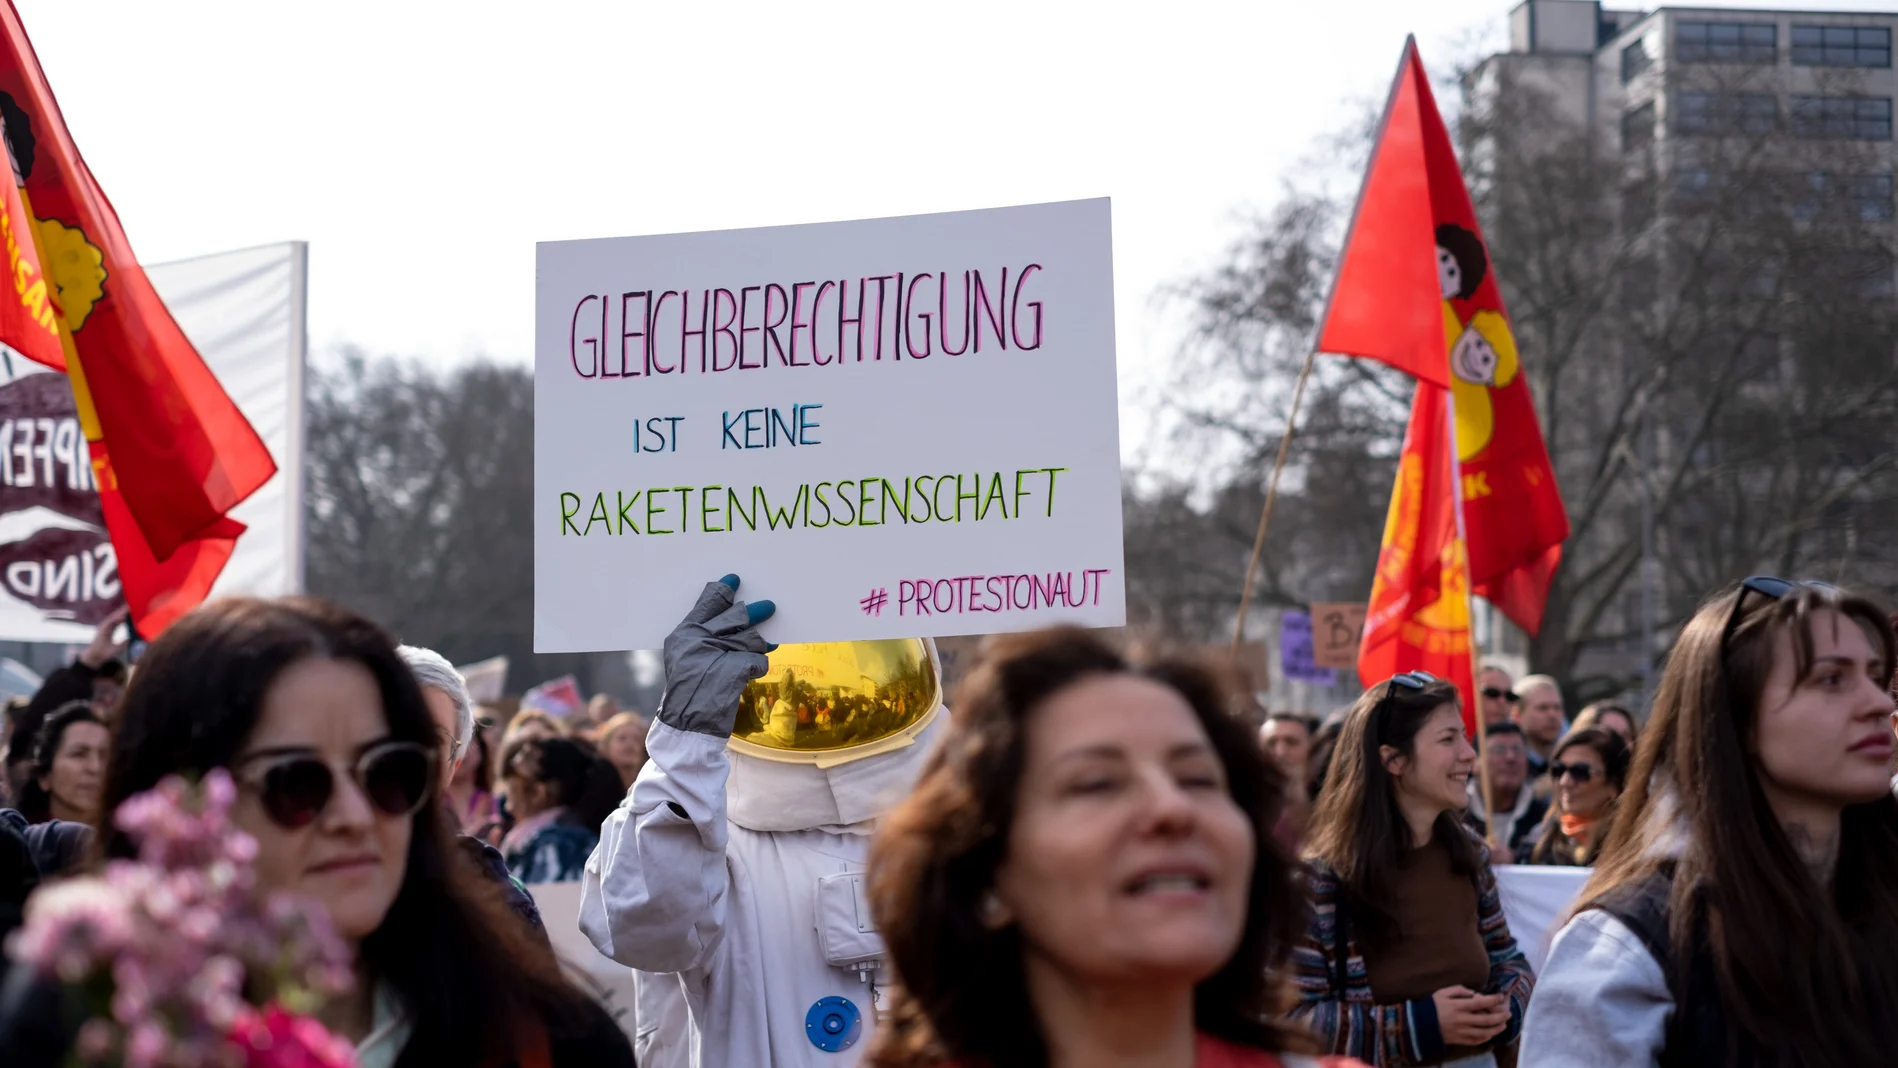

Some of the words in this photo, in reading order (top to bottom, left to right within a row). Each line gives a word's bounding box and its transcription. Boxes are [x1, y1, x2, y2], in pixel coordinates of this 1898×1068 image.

[568, 263, 1044, 380] GLEICHBERECHTIGUNG
[633, 416, 686, 453] IST
[721, 403, 824, 450] KEINE
[560, 468, 1070, 536] RAKETENWISSENSCHAFT
